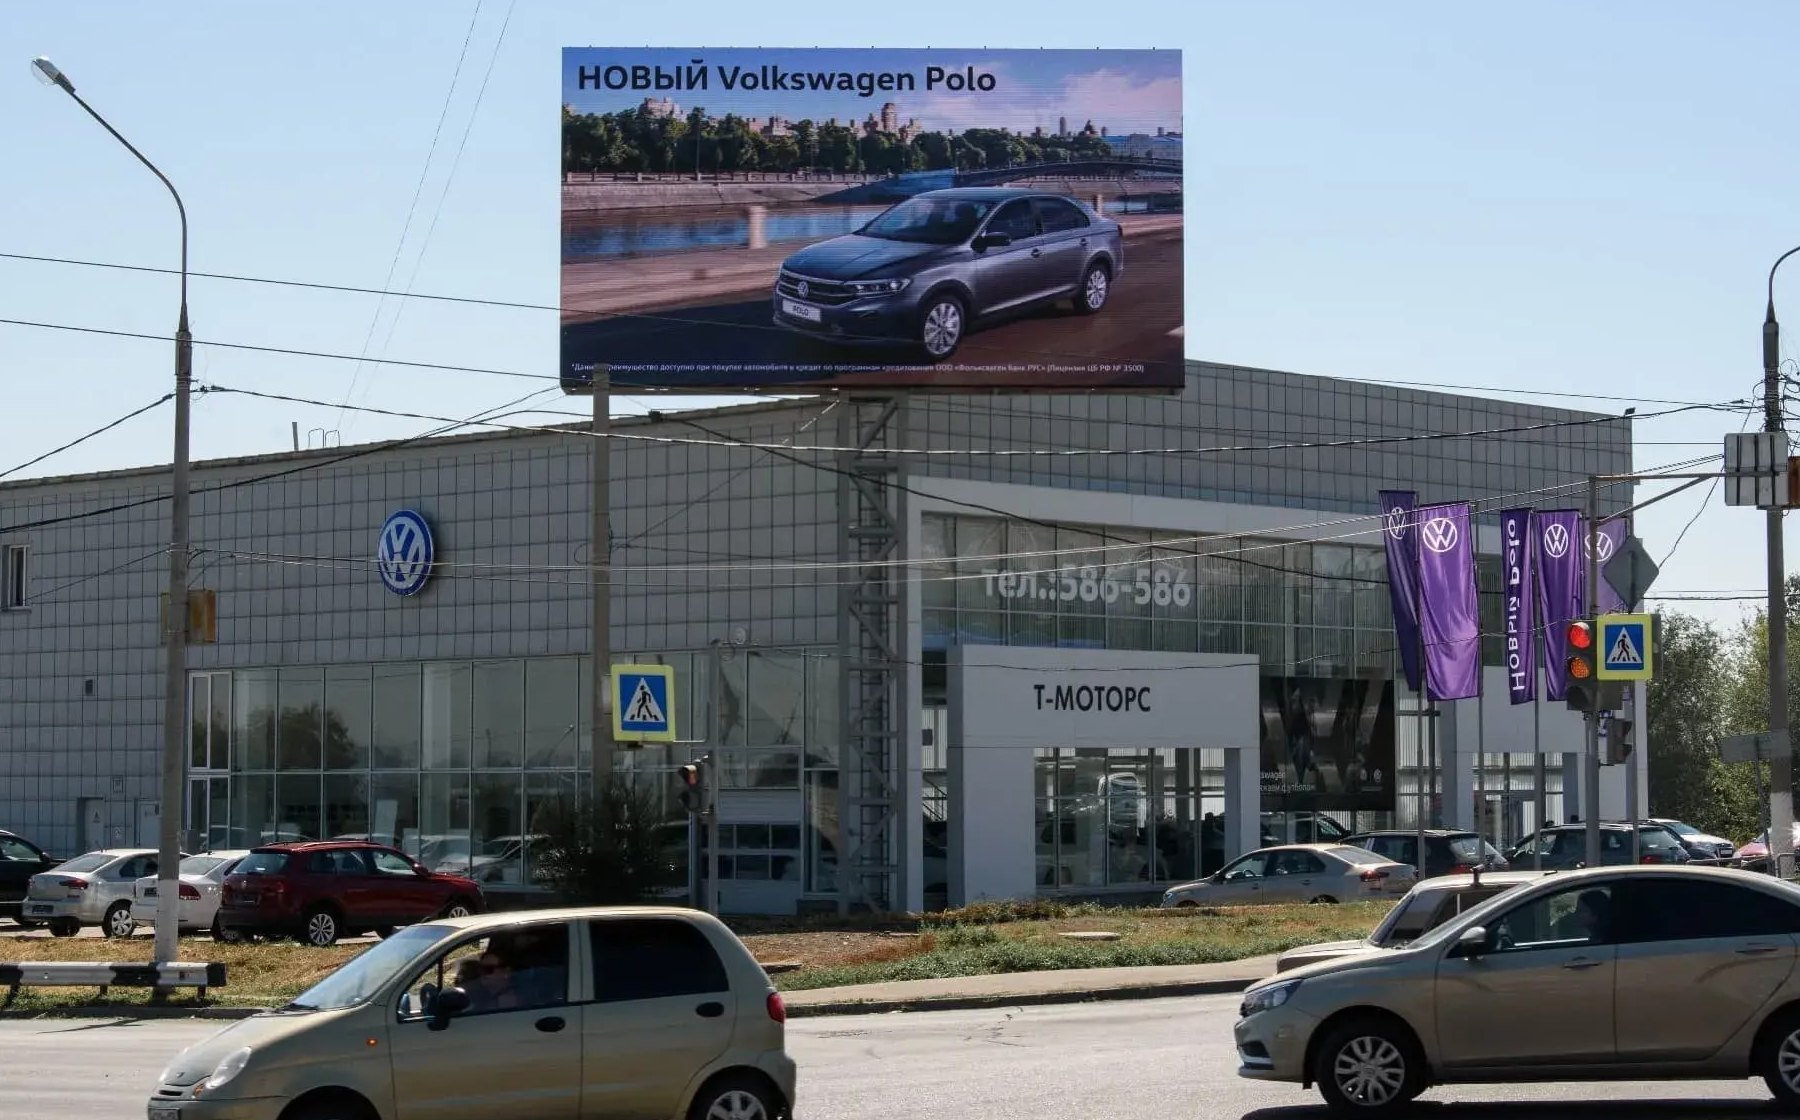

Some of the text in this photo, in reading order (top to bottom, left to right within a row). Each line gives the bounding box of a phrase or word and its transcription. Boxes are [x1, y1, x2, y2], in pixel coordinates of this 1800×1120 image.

[578, 58, 996, 98] НОВЫЙ Volkswagen Polo
[935, 363, 953, 372] ООО
[1033, 684, 1151, 712] Т-МОТОРС
